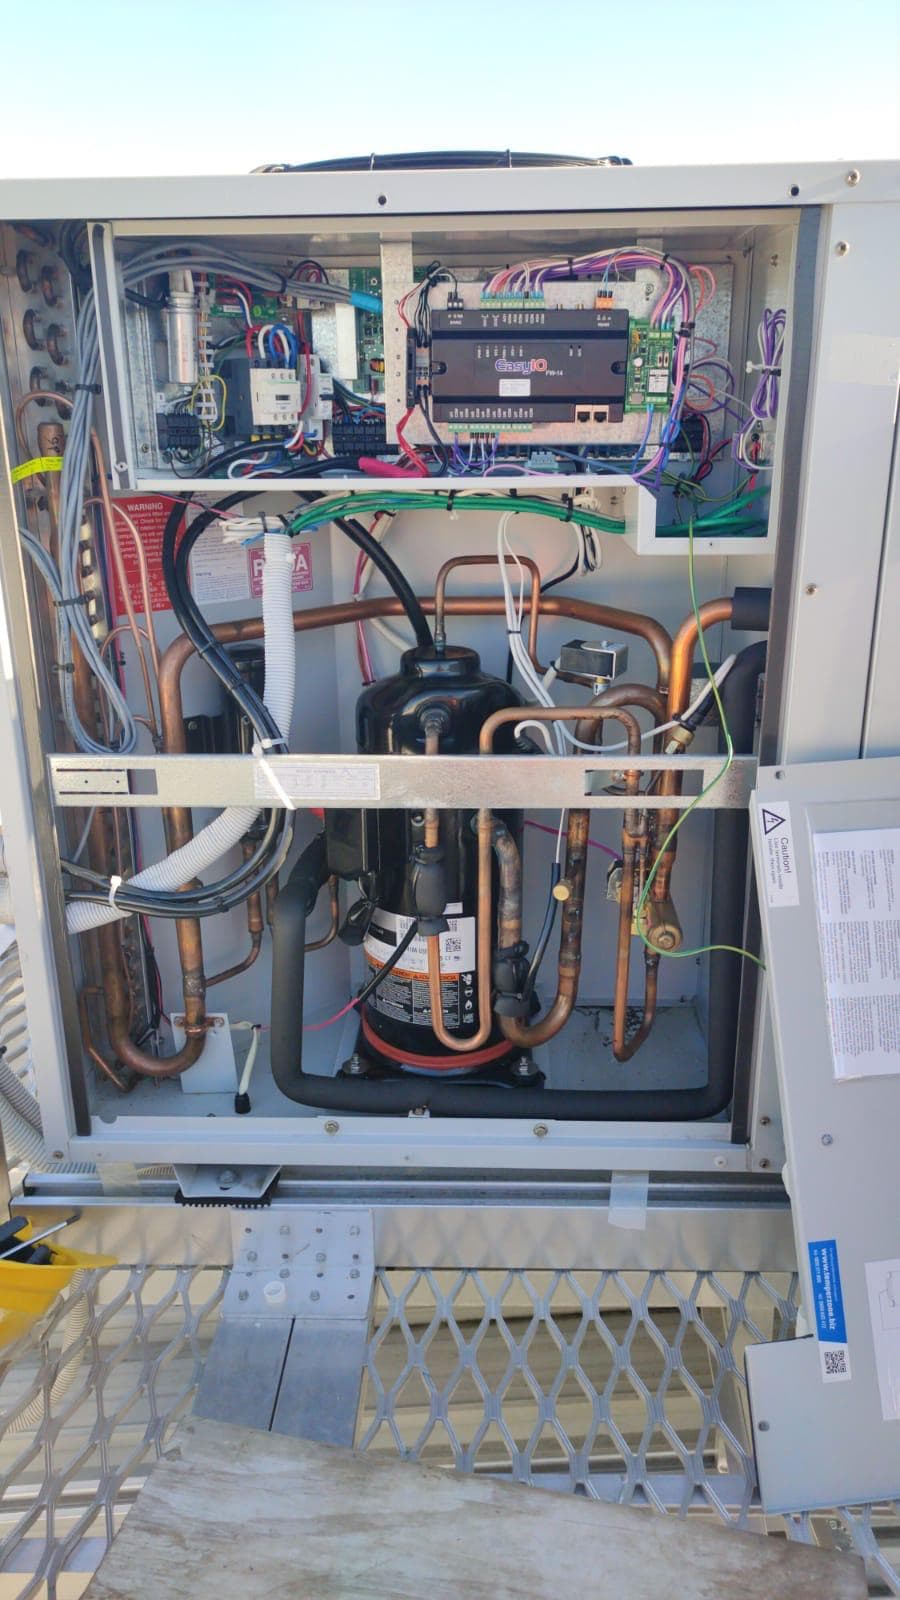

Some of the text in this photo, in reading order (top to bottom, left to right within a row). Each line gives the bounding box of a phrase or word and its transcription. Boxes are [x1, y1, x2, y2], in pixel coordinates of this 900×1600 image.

[494, 358, 548, 375] EasyIO
[127, 502, 164, 512] WARNING
[781, 837, 792, 874] Caution!
[821, 1248, 836, 1330] www.temperzone.biz
